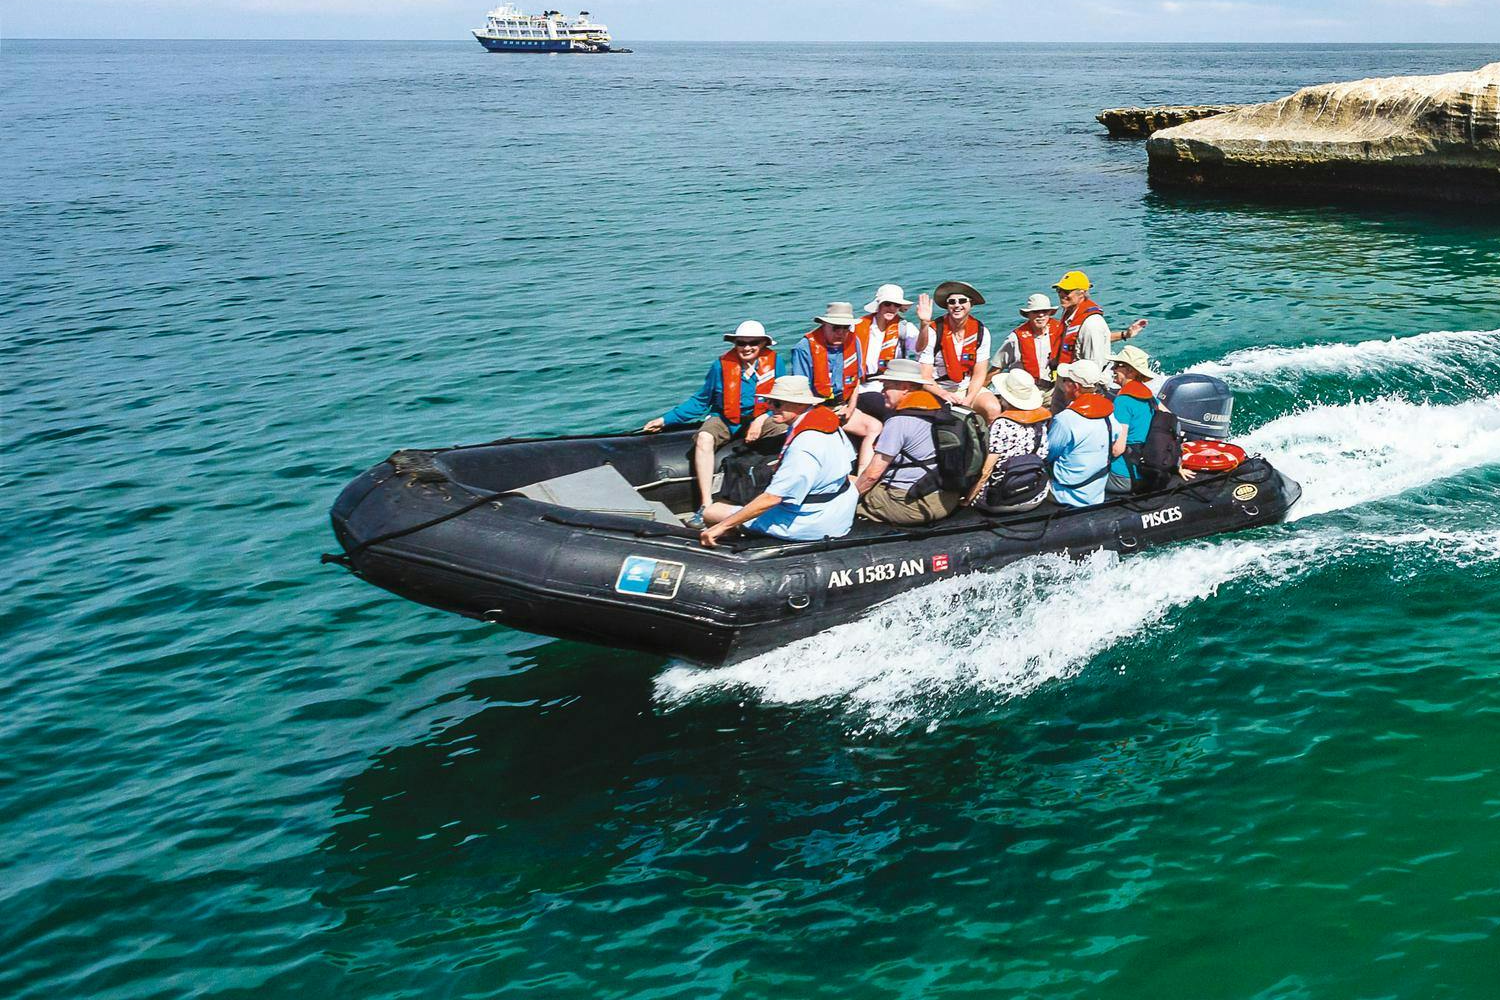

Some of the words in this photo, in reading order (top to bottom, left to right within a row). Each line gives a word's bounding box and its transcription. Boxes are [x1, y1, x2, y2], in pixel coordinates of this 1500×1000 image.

[1141, 506, 1182, 529] PISCES
[828, 569, 853, 588] AK
[855, 563, 895, 584] 1583
[898, 558, 924, 578] AN
